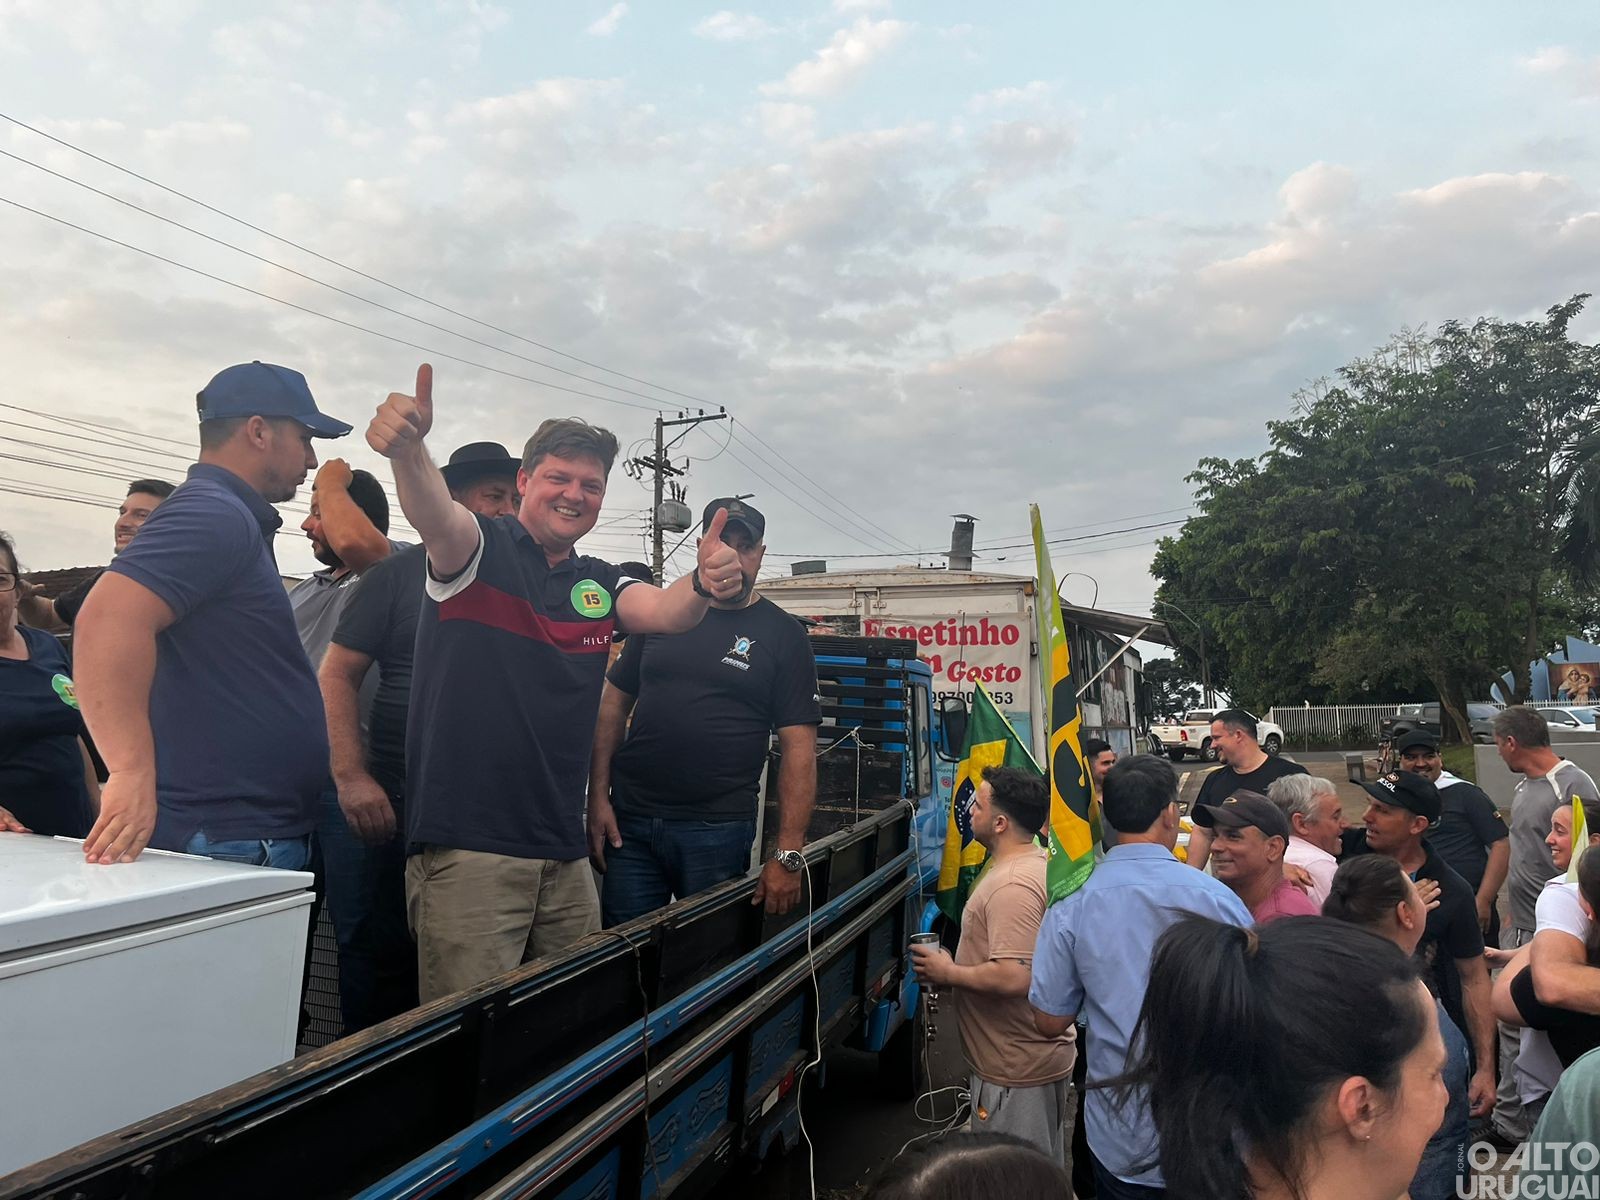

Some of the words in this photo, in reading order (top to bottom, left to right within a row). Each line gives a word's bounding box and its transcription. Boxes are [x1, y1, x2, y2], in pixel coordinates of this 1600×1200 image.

[583, 593, 601, 606] 15
[583, 635, 609, 646] HILF
[947, 660, 1022, 683] Gosto
